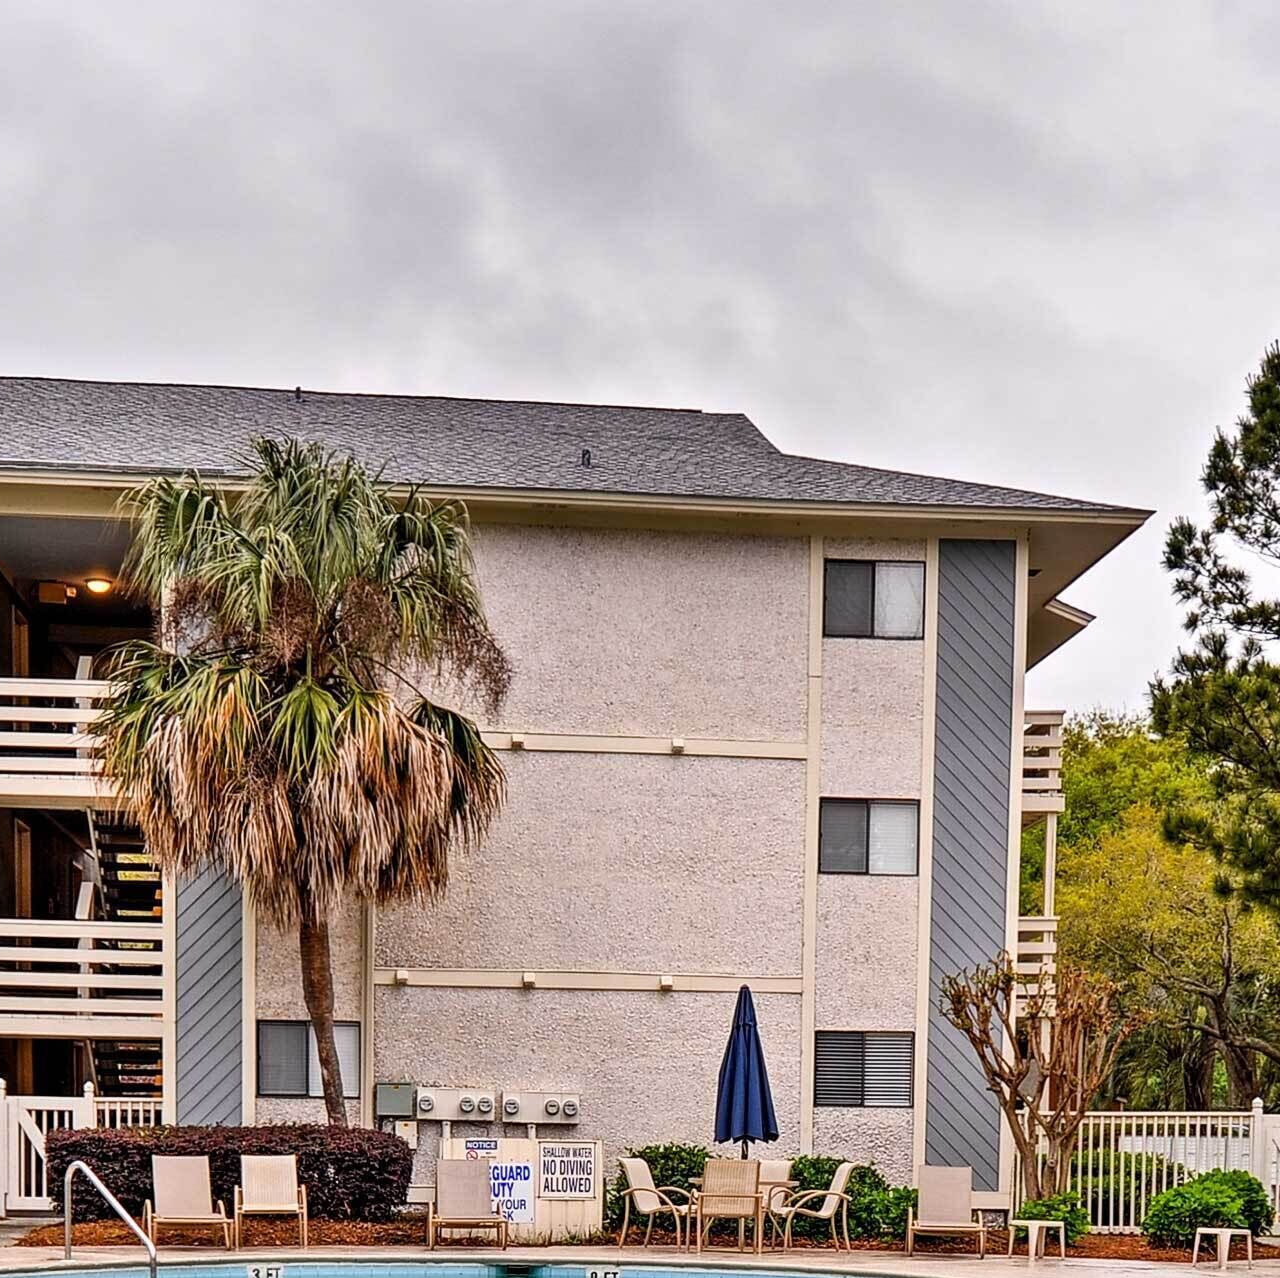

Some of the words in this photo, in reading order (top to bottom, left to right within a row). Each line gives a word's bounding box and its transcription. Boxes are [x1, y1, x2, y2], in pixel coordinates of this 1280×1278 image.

[466, 1141, 497, 1149] NOTICE
[542, 1147, 570, 1158] SHALLOW
[572, 1147, 592, 1158] WATER
[489, 1165, 531, 1181] GUARD
[543, 1160, 556, 1175] NO
[559, 1160, 592, 1176] DIVING
[490, 1182, 514, 1198] UTY
[543, 1177, 591, 1193] ALLOWED
